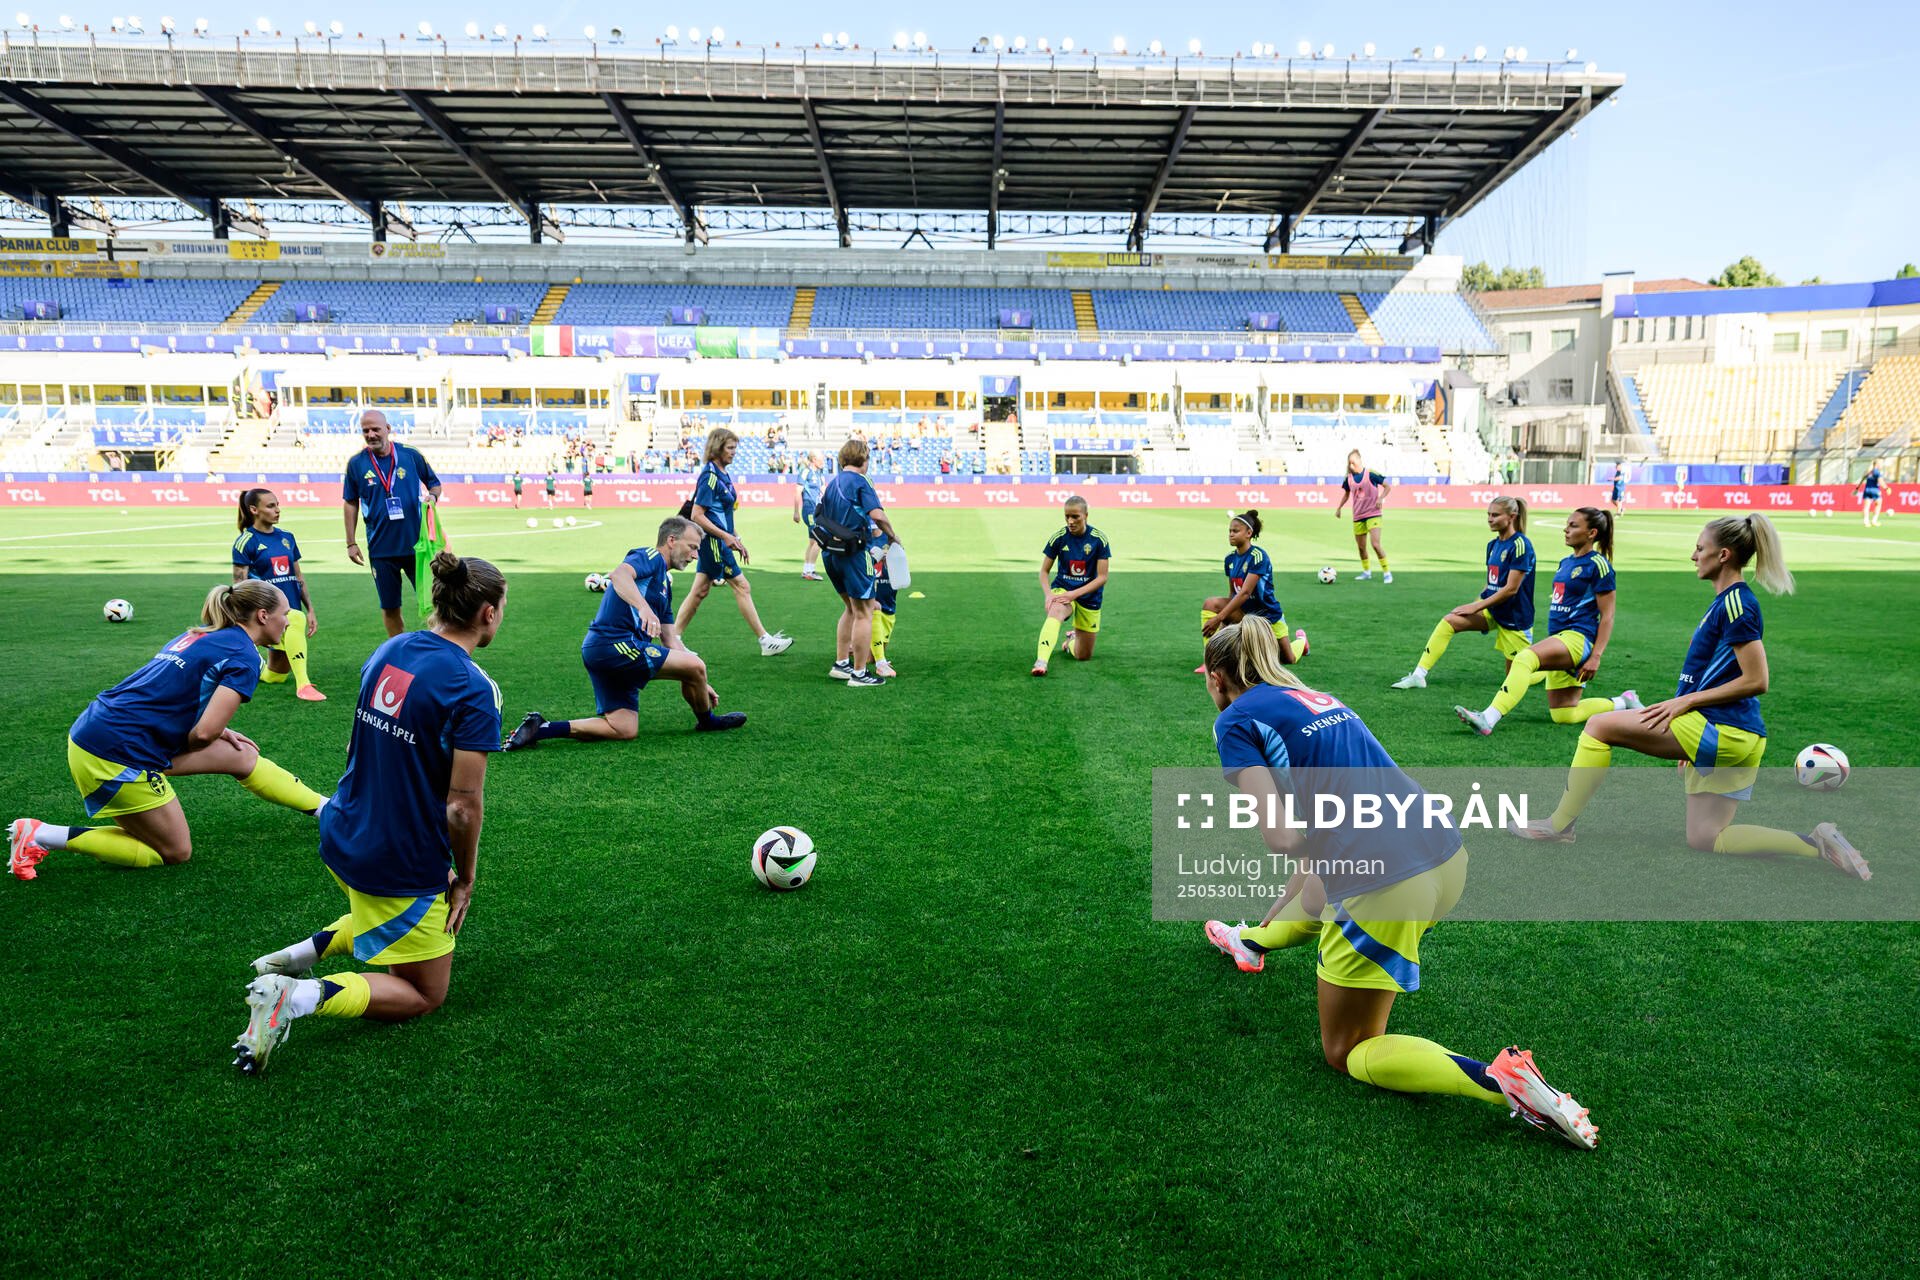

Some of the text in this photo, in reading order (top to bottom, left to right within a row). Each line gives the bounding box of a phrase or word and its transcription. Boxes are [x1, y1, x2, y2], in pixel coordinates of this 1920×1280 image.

[0, 240, 80, 251] PARMA CLUB
[578, 334, 609, 347] FIFA
[658, 335, 693, 349] UEFA
[7, 489, 46, 501] TCL
[88, 489, 126, 501] TCL
[152, 489, 190, 501] TCL
[217, 489, 240, 502] TC
[283, 489, 320, 502] TCL
[475, 490, 512, 502] TCL
[616, 490, 652, 502] TCL
[740, 490, 775, 502] TCL
[877, 490, 896, 502] CL
[925, 490, 960, 502] TCL
[984, 490, 1019, 502] TCL
[1118, 491, 1152, 503] TCL
[1176, 491, 1211, 503] TCL
[1236, 491, 1270, 503] TCL
[1295, 491, 1328, 503] TCL
[1413, 491, 1447, 504] TCL
[1529, 491, 1563, 503] TCL
[1602, 491, 1636, 504] TL
[1661, 491, 1697, 504] TCL
[1724, 492, 1751, 504] TCL
[1769, 493, 1793, 505] TCL
[1811, 493, 1835, 505] TCL
[357, 708, 416, 745] SENSKA SPEL
[1301, 711, 1352, 737] SVENSKA
